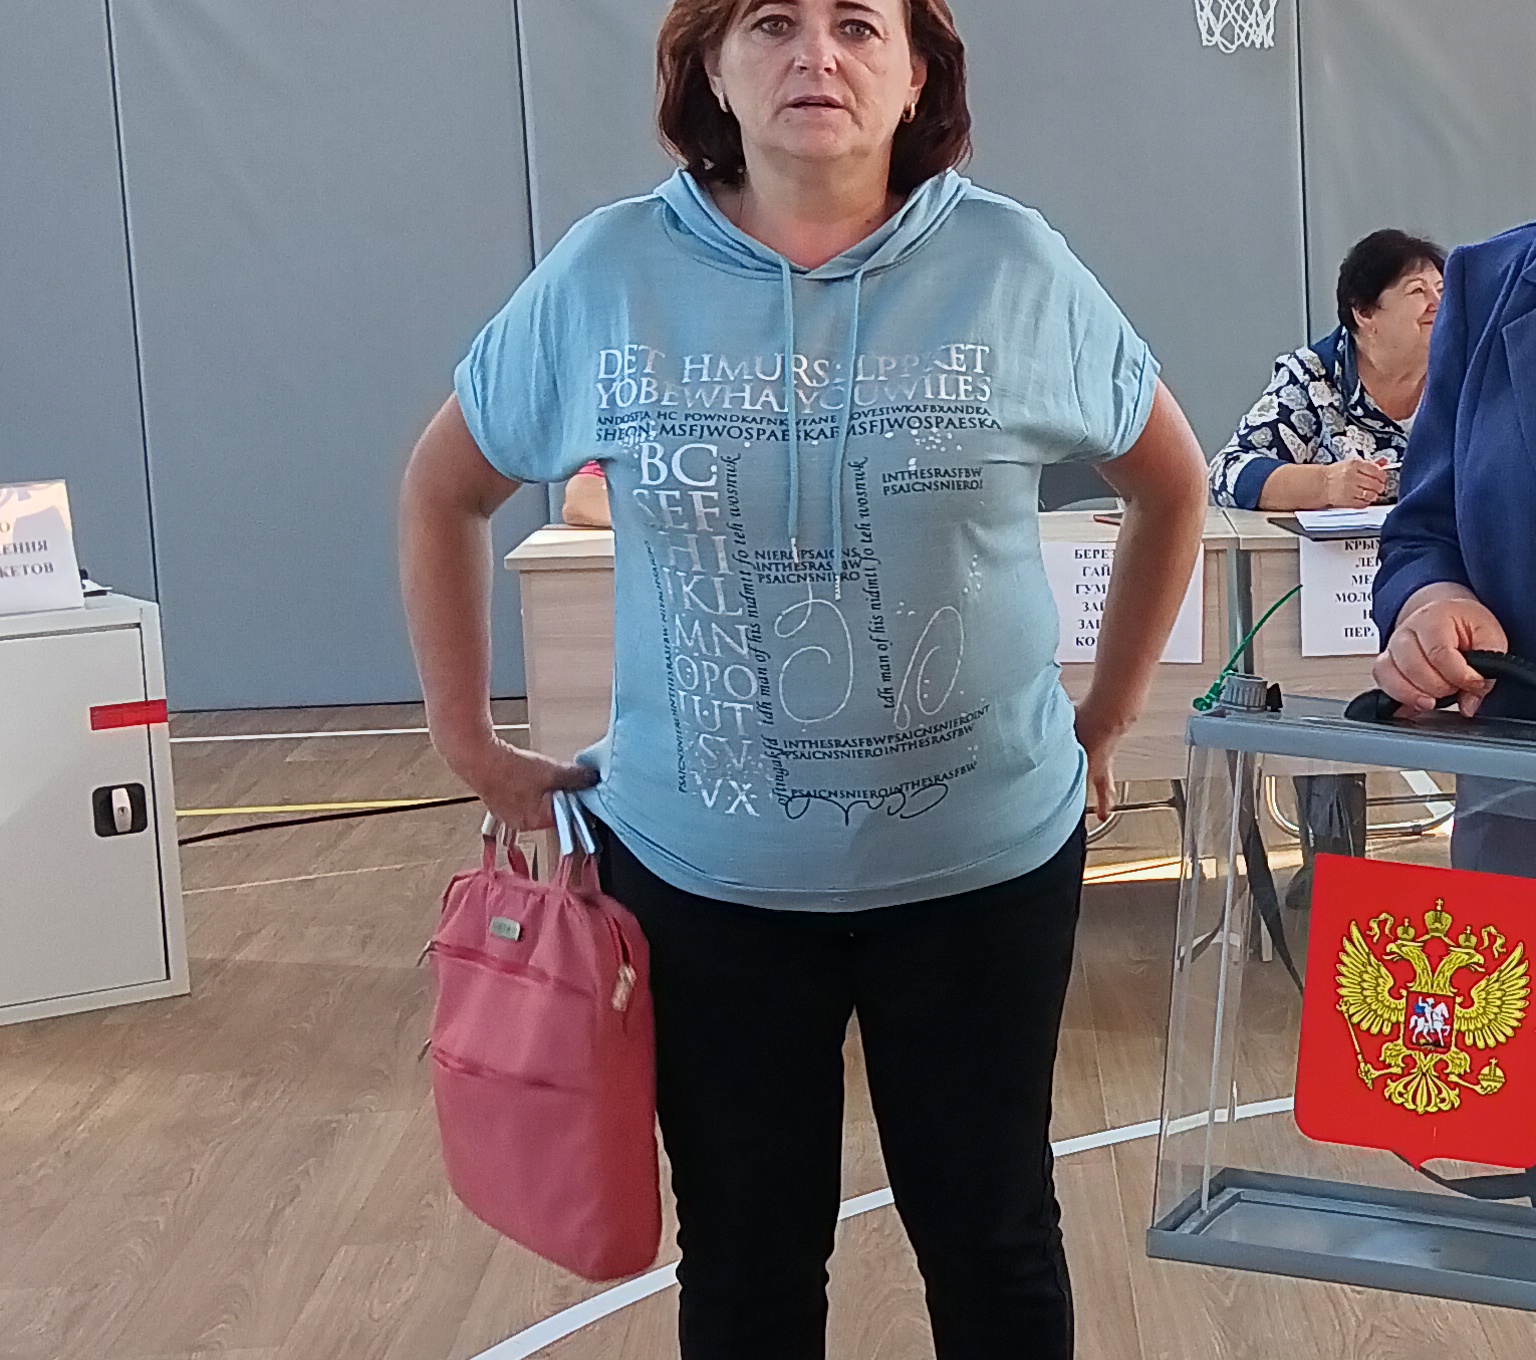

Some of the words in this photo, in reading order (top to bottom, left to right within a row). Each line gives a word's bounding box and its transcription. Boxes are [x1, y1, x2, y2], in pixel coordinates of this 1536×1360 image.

[598, 343, 666, 380] DET
[639, 441, 718, 487] BC
[0, 540, 48, 556] ЕНИЯ
[867, 614, 886, 634] his
[1344, 627, 1375, 638] ПЕР
[674, 614, 750, 660] MN
[869, 634, 893, 652] of
[1075, 636, 1098, 647] КО
[878, 655, 892, 683] man
